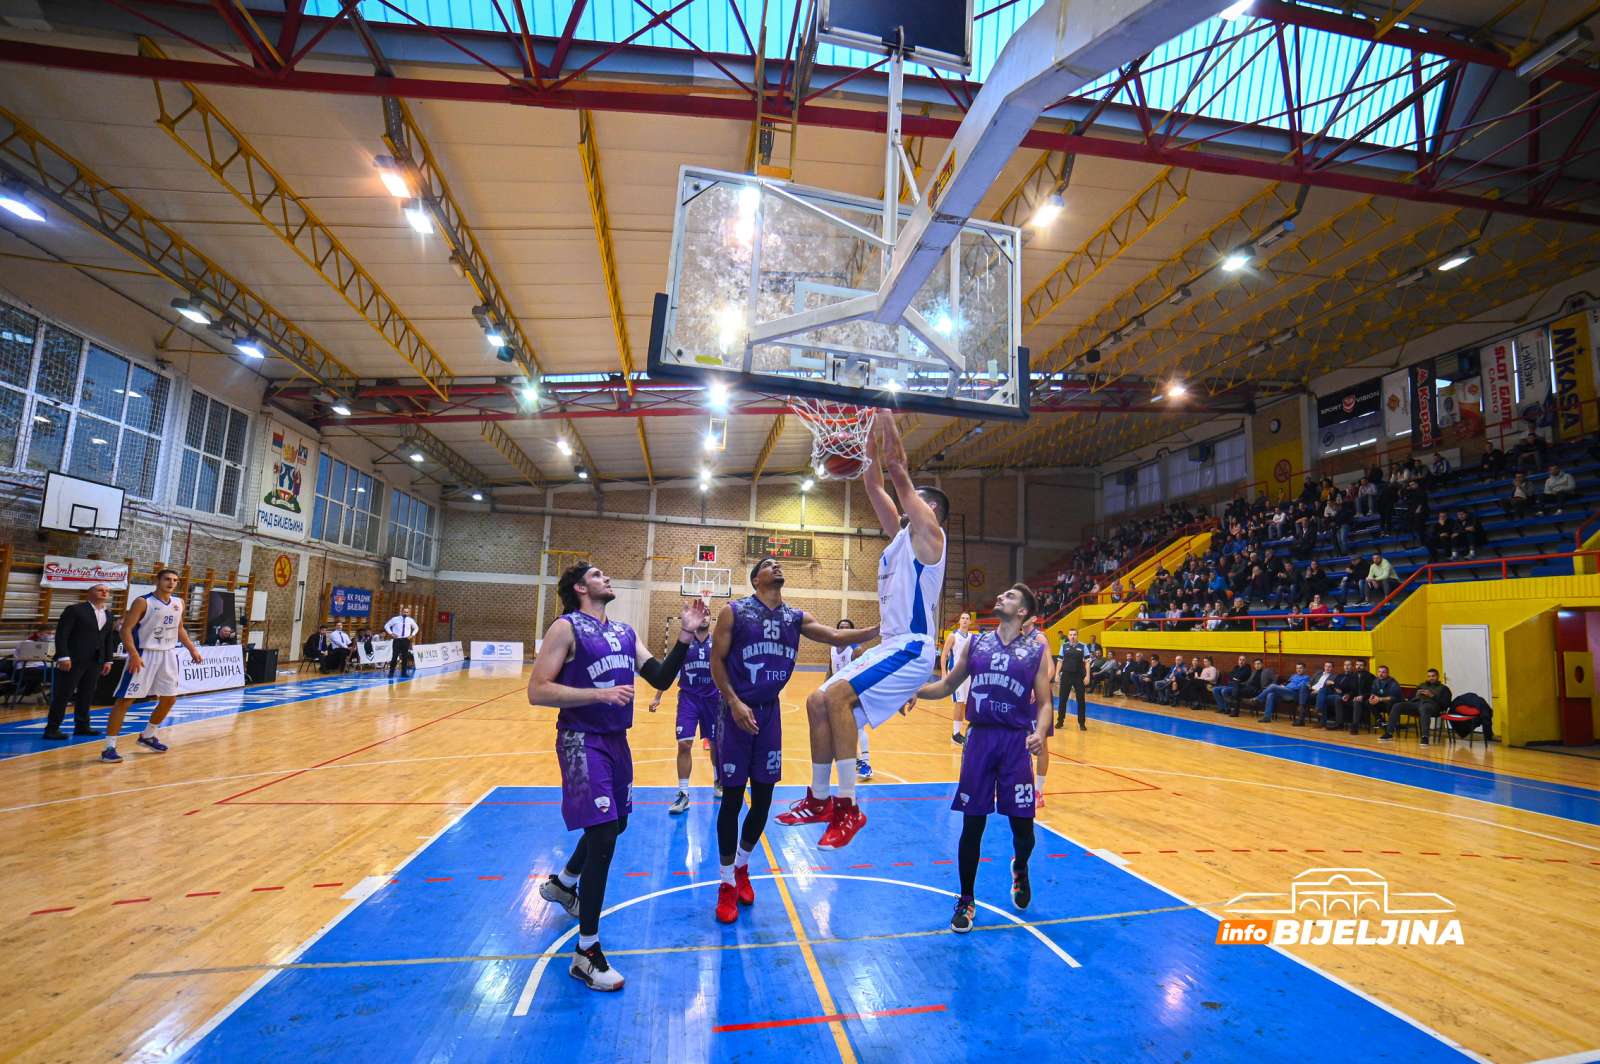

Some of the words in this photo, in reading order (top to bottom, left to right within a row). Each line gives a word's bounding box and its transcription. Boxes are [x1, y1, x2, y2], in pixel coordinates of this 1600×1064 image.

[1495, 345, 1508, 383] SLOT
[1552, 328, 1580, 431] MIKASA
[1488, 367, 1498, 414] CASINO
[1417, 385, 1432, 448] Kappa
[258, 510, 273, 529] ГРАД
[163, 615, 173, 625] 26
[763, 619, 780, 640] 25
[698, 648, 705, 660] 5
[990, 652, 1010, 671] 23
[184, 665, 241, 681] БИЈЕЉИНА
[128, 683, 139, 692] 26
[1014, 783, 1034, 804] 23
